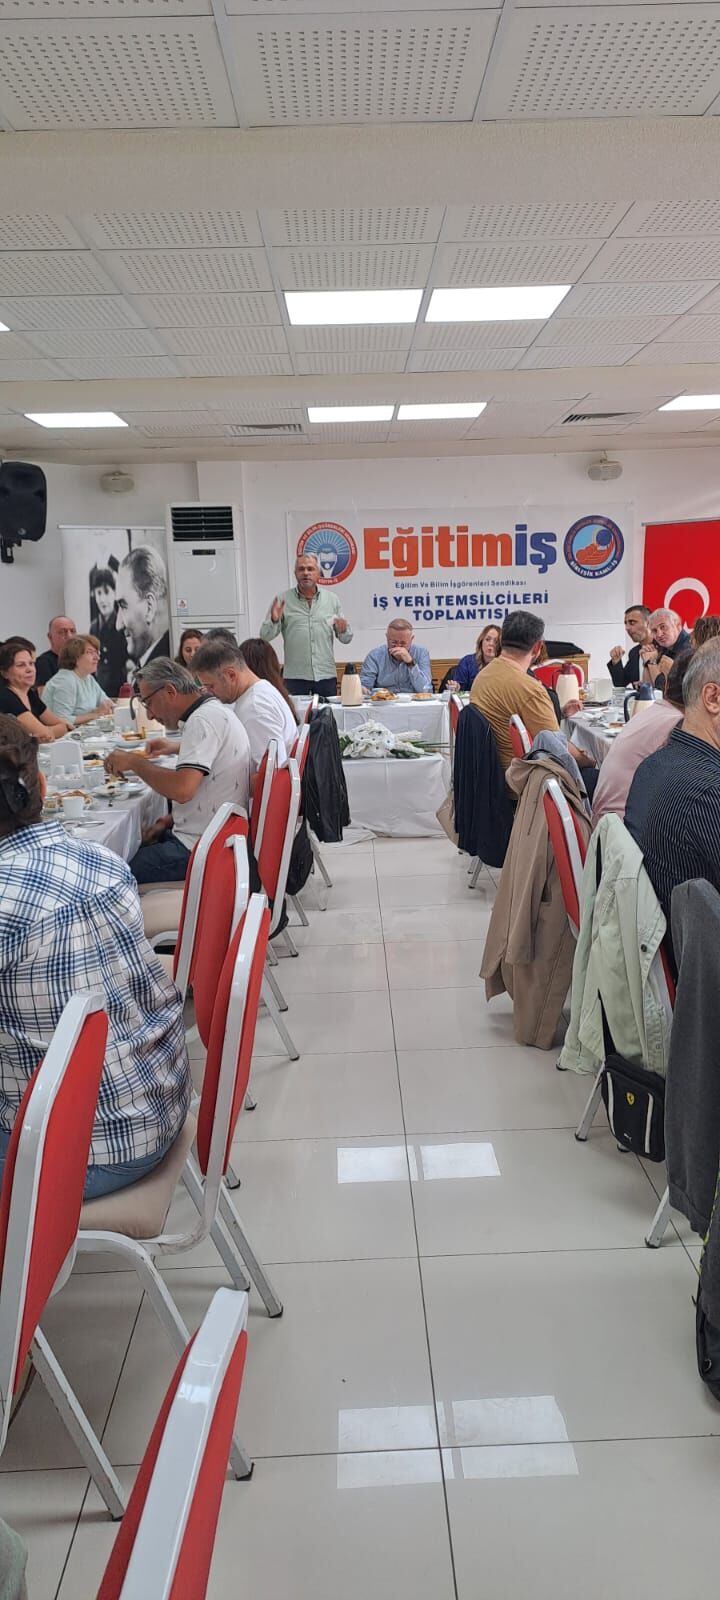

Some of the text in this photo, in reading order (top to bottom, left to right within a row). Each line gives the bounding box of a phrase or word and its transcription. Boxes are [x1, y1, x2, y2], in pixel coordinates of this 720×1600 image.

[395, 581, 419, 590] Eğitim
[430, 580, 449, 588] Bilim
[490, 579, 527, 587] Sendikası
[373, 589, 549, 610] İŞ YERİ TEMSİLCİLERİ
[412, 608, 509, 621] TOPLANTISI
